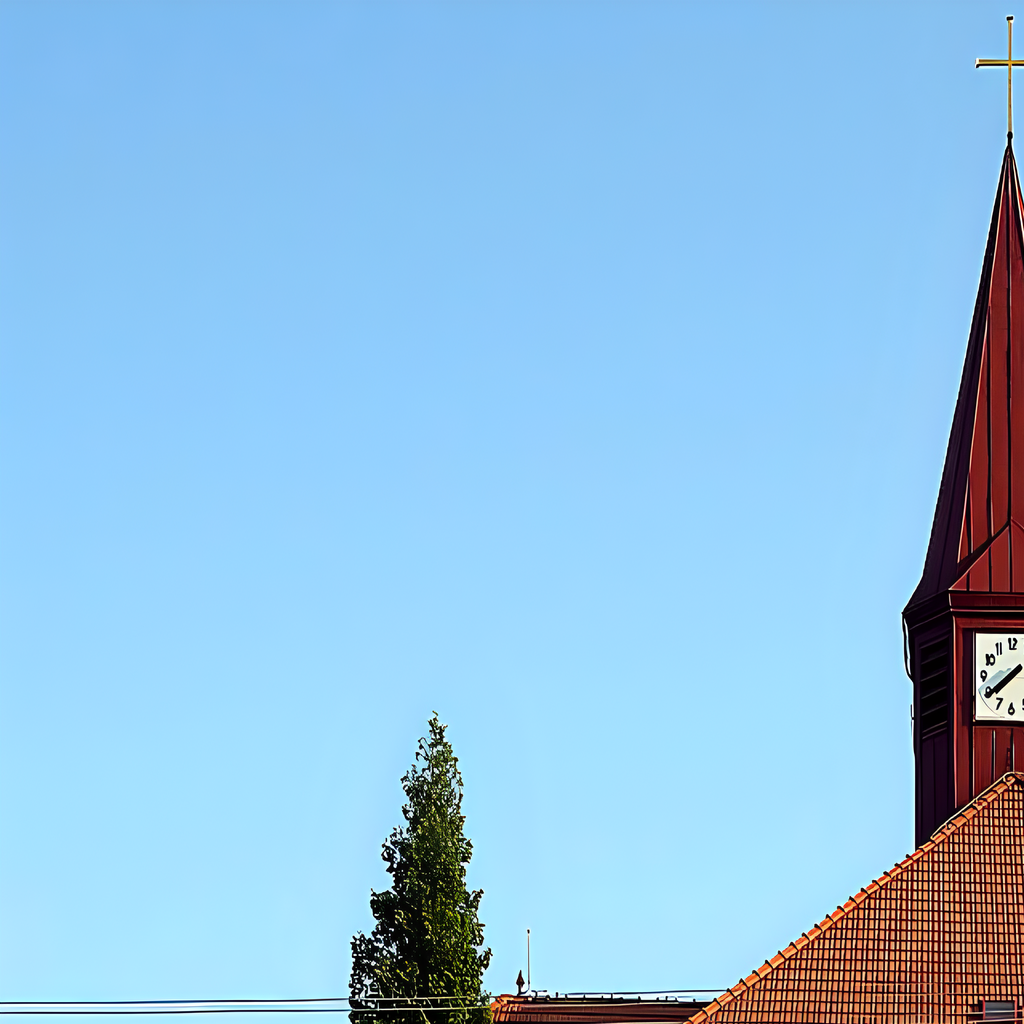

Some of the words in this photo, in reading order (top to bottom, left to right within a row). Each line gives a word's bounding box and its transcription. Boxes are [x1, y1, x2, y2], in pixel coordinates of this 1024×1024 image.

[995, 642, 1003, 656] 11
[1007, 637, 1018, 651] 12
[985, 653, 996, 666] 10
[980, 669, 988, 682] 9
[995, 697, 1004, 710] 7
[1007, 702, 1016, 716] 6
